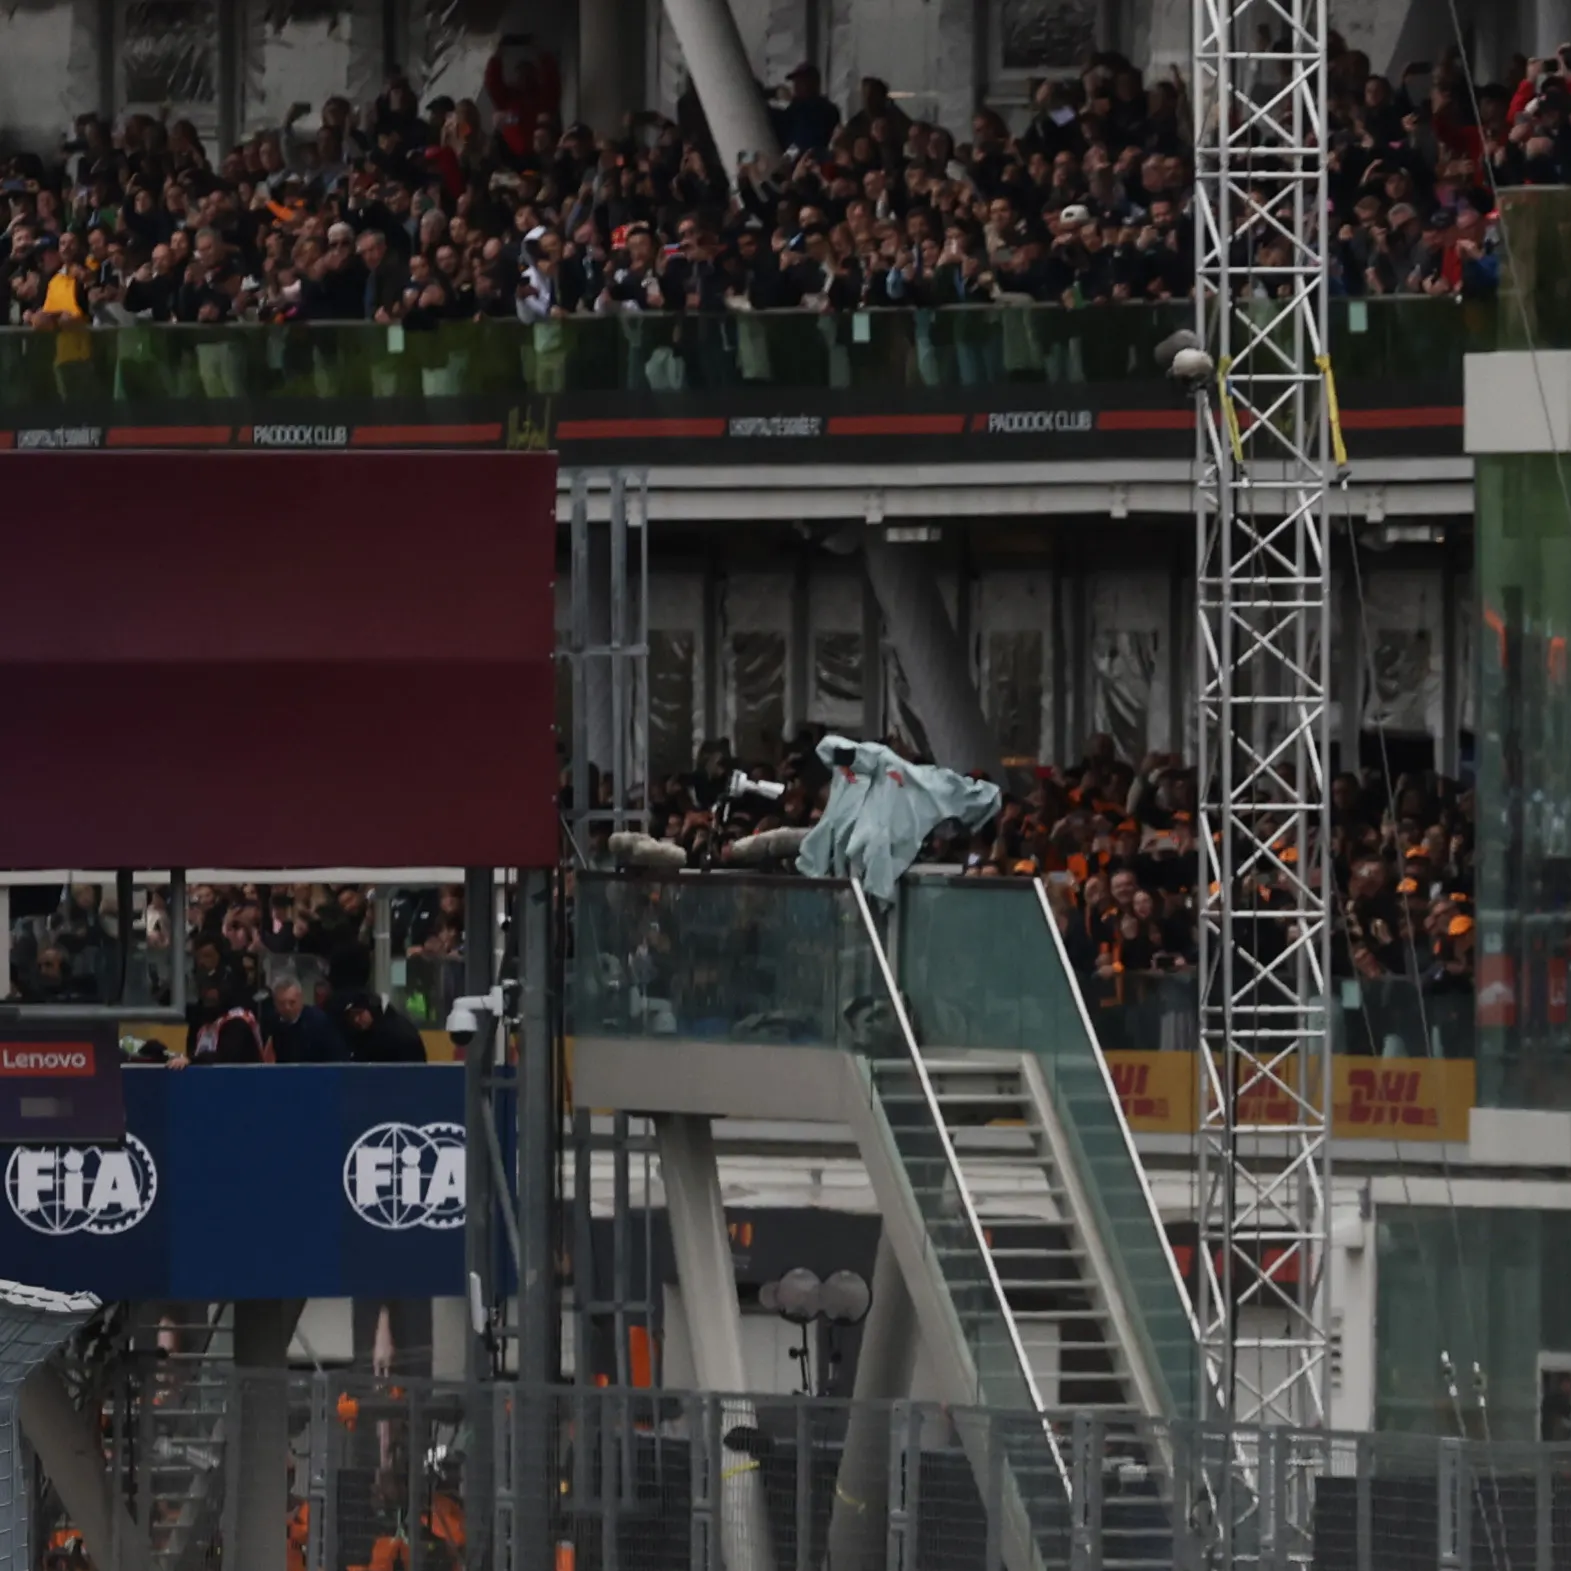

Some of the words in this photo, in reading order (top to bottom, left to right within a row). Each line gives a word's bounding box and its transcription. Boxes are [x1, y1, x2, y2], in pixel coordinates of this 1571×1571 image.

[989, 411, 1054, 432] PADDOCK
[1055, 411, 1092, 431] CLUB
[254, 425, 312, 444] PADDOCK
[314, 425, 347, 445] CLUB
[2, 1047, 87, 1069] Lenovo
[1348, 1069, 1438, 1125] DHL
